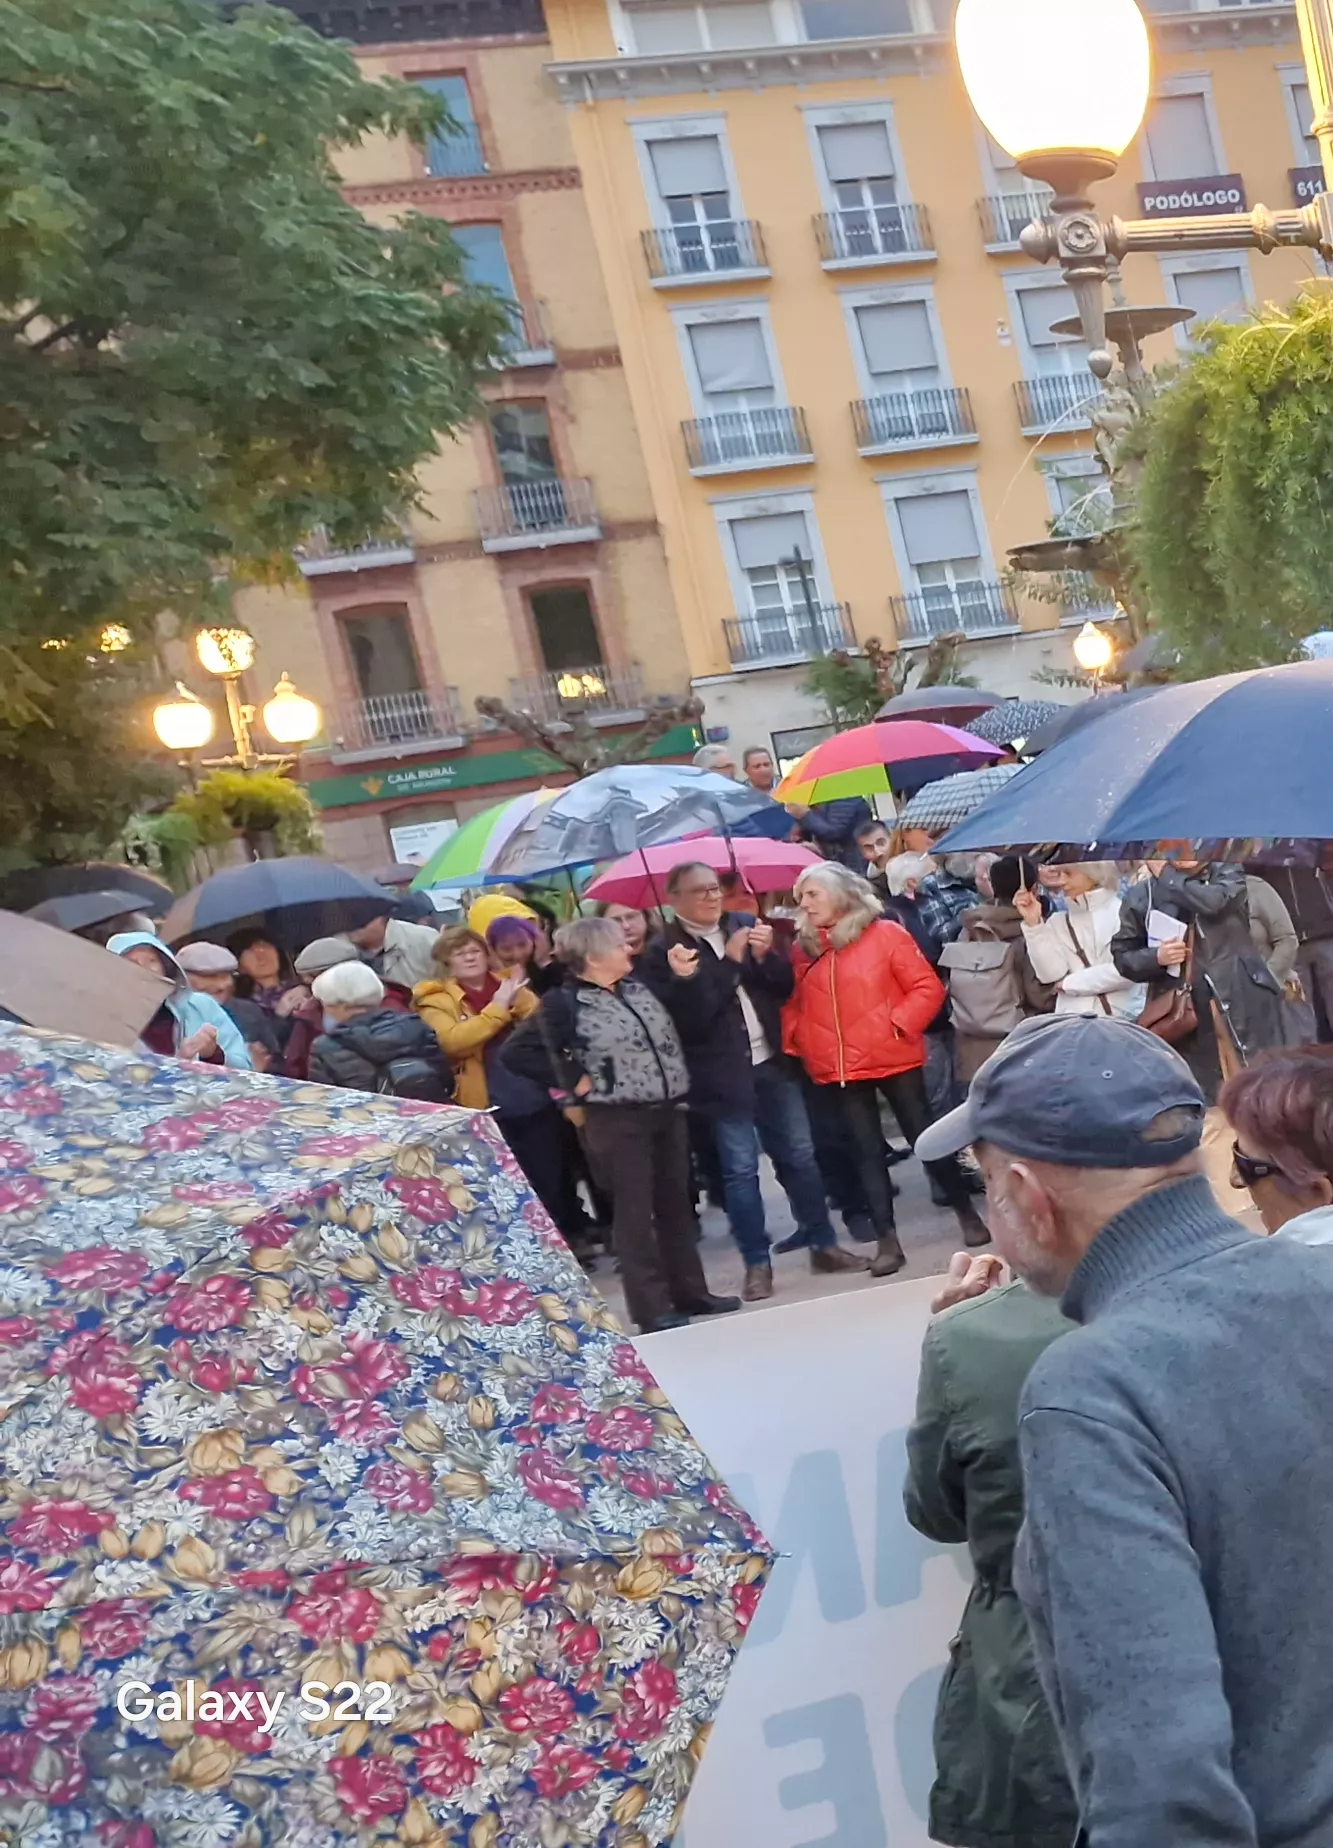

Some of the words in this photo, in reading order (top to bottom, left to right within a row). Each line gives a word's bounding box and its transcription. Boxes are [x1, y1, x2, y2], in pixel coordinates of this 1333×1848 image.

[1297, 180, 1323, 197] 611
[1144, 189, 1240, 211] PODÓLOGO
[387, 772, 418, 785] CAJA
